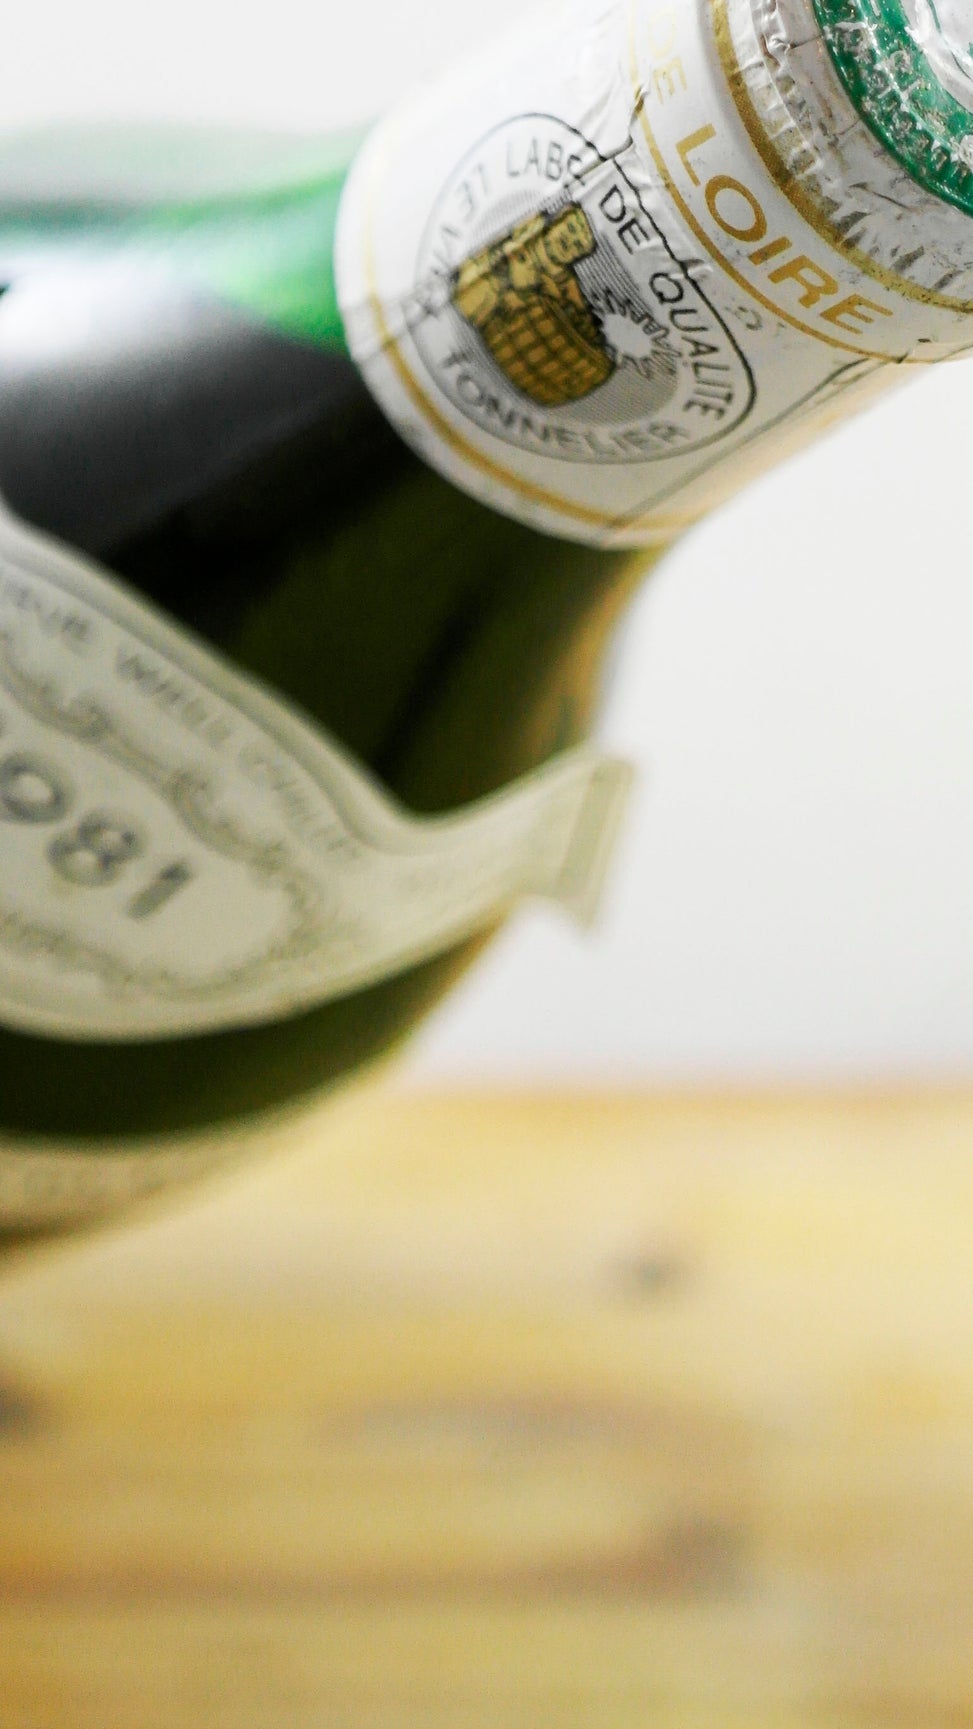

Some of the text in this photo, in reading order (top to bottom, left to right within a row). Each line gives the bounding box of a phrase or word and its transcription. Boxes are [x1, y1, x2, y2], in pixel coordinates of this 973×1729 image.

[599, 183, 651, 255] DE
[648, 271, 734, 420] QUALITE
[675, 123, 894, 335] LOIRE
[442, 349, 692, 460] TONNELIER
[0, 744, 193, 922] 981
